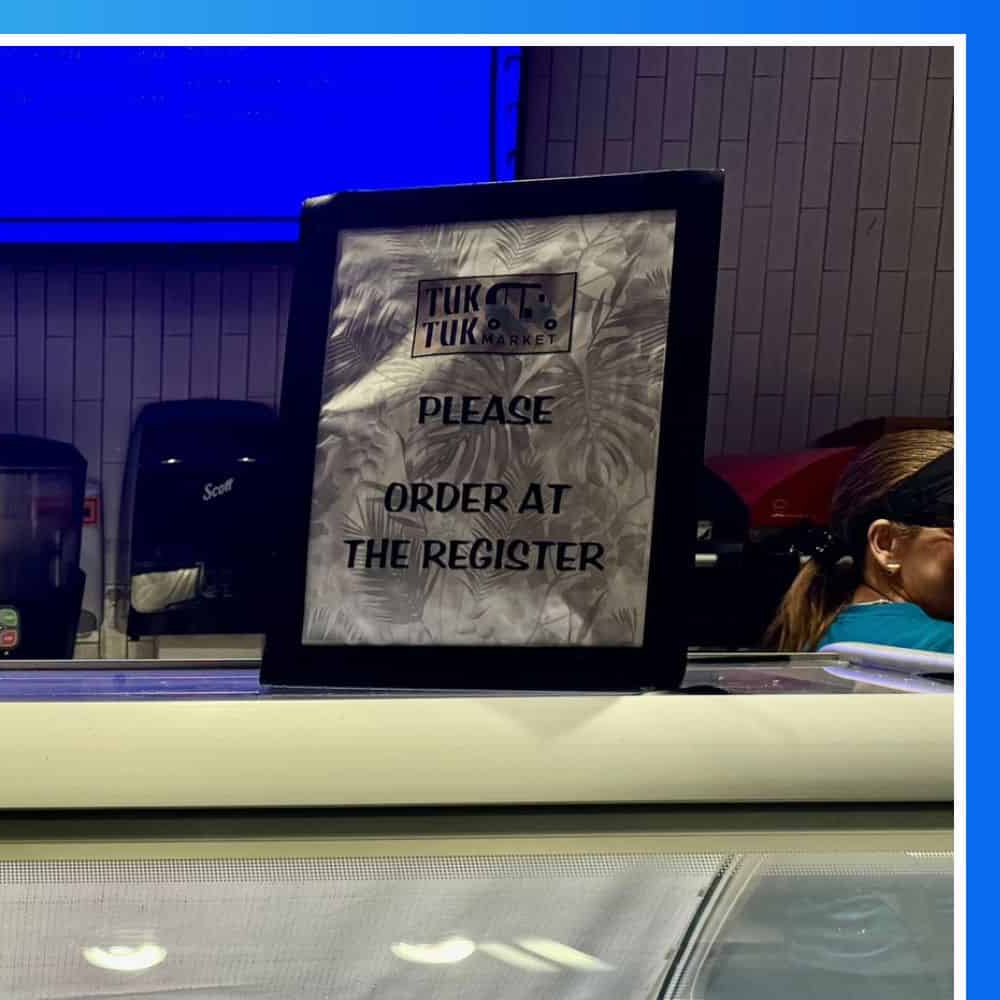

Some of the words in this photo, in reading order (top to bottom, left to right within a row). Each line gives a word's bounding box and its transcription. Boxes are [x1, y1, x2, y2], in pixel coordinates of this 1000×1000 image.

[424, 284, 482, 315] TUK
[422, 319, 480, 348] TUK
[481, 333, 558, 346] MARKET
[417, 396, 554, 425] PLEASE
[384, 483, 508, 513] ORDER
[517, 484, 572, 514] AT
[343, 539, 411, 569] THE
[421, 540, 605, 572] REGISTER
